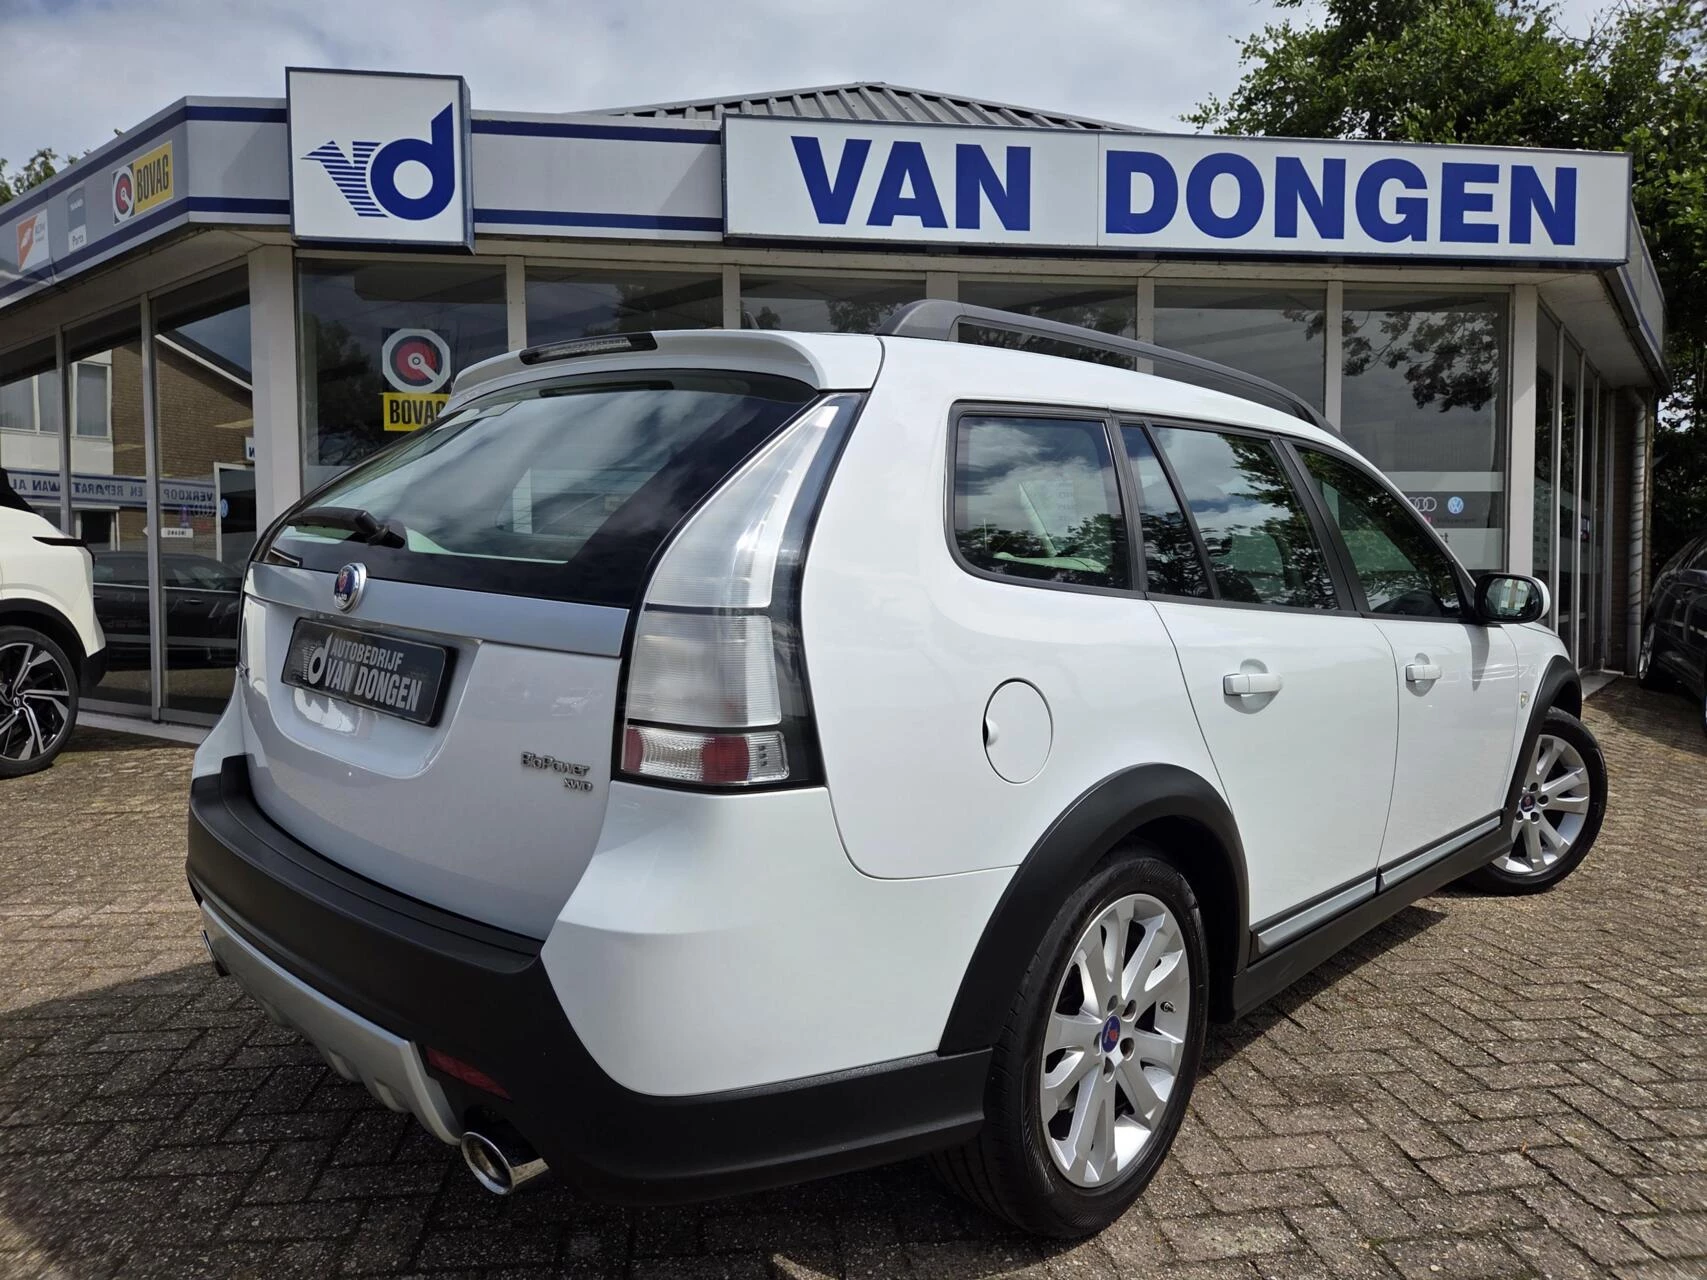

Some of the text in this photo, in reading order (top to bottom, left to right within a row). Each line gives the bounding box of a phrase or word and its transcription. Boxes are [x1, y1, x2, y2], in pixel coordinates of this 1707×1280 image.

[136, 154, 169, 203] BOVAG
[791, 136, 1578, 246] VAN DONGEN
[330, 638, 404, 671] AUTOBEDRIJF
[324, 658, 423, 712] VAN DONGEN
[521, 751, 591, 776] BioPower
[564, 777, 594, 792] XWD
